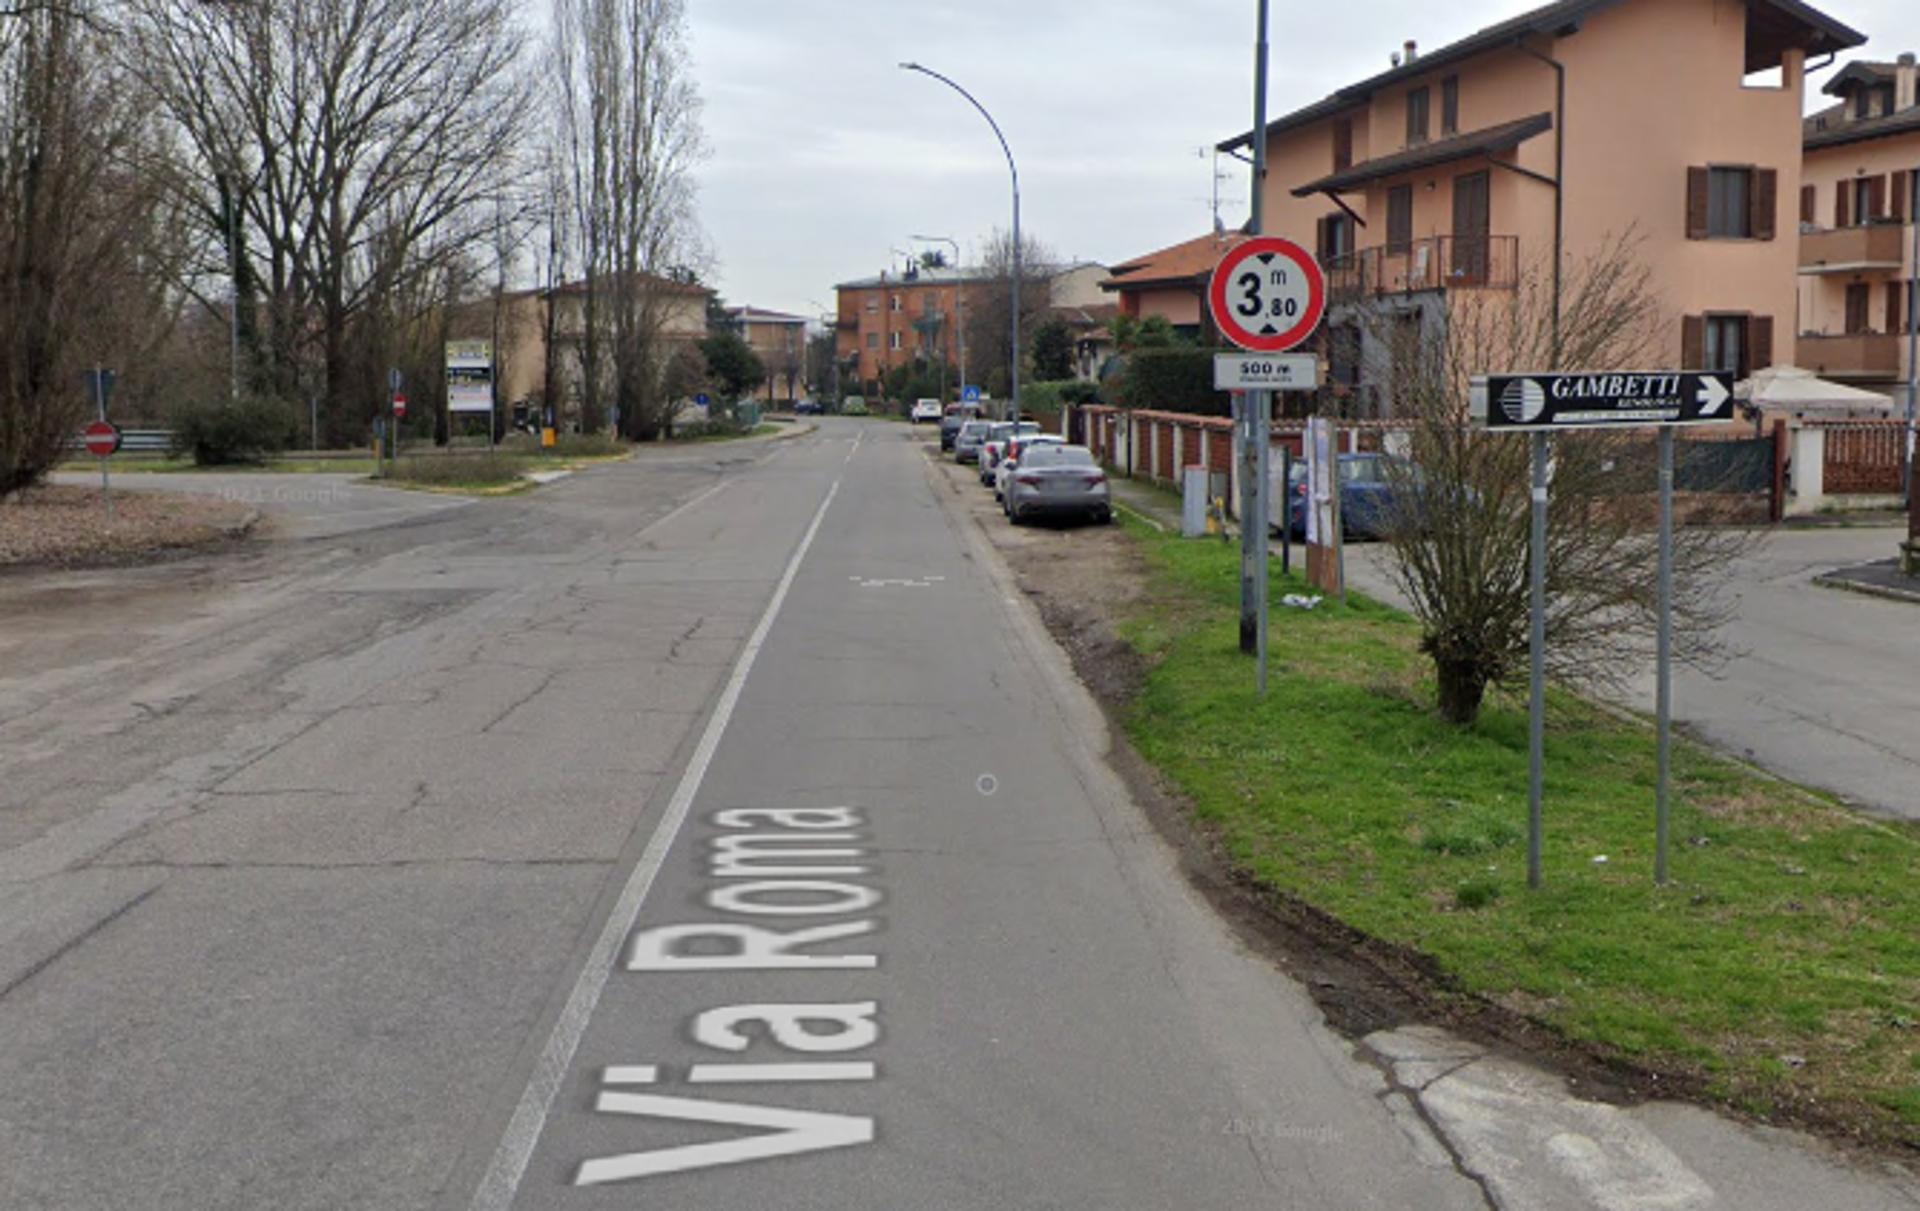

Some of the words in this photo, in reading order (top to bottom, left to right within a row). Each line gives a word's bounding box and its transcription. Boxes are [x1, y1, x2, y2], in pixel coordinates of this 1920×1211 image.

[1271, 269, 1287, 285] m
[1240, 361, 1272, 374] 500
[1552, 374, 1681, 399] GAMBETTI
